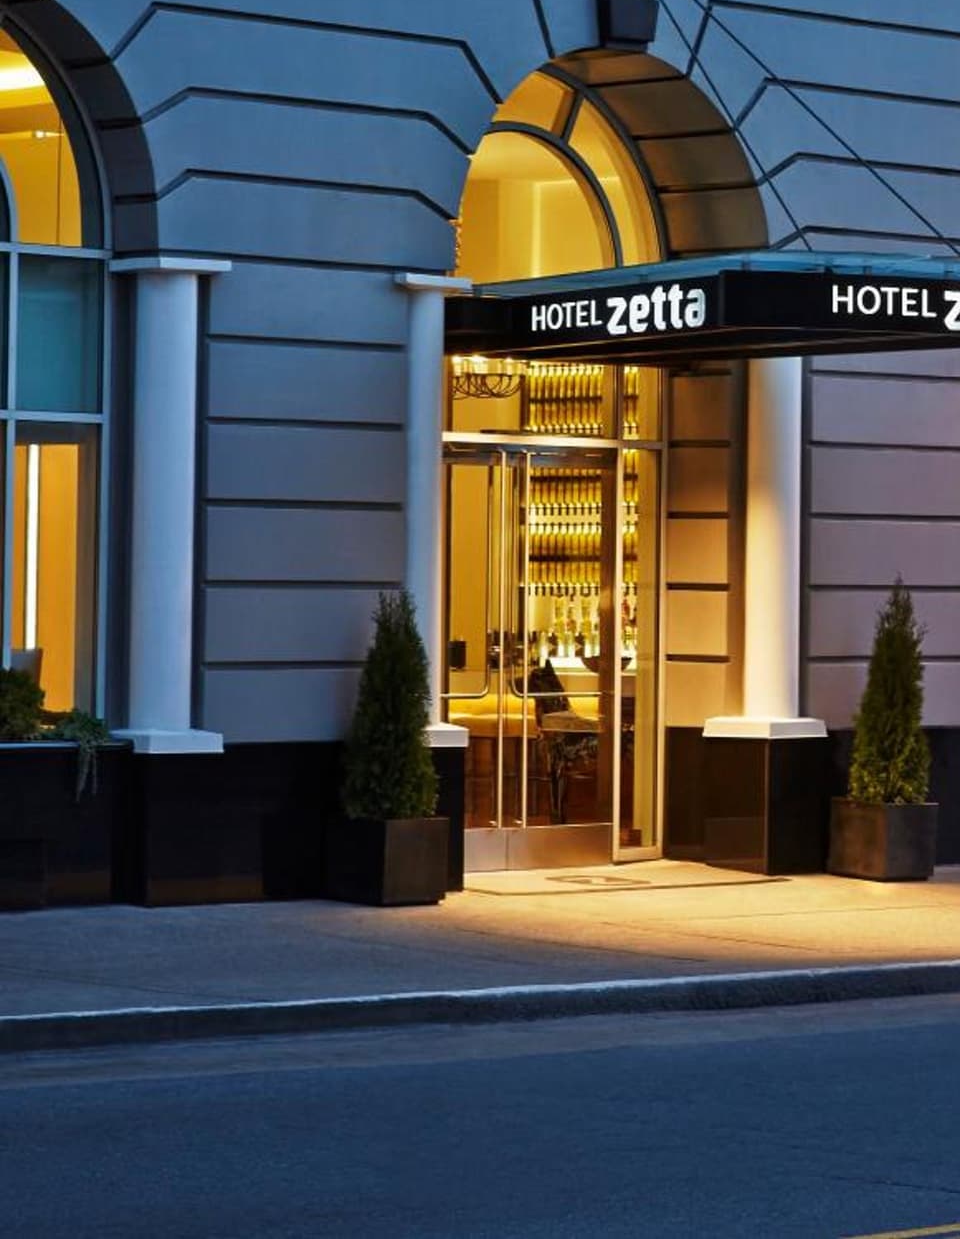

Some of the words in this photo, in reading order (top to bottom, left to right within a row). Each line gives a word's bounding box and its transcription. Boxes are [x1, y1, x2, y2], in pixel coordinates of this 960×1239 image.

[531, 299, 602, 332] HOTEL
[606, 283, 706, 335] zetta
[832, 285, 937, 318] HOTEL
